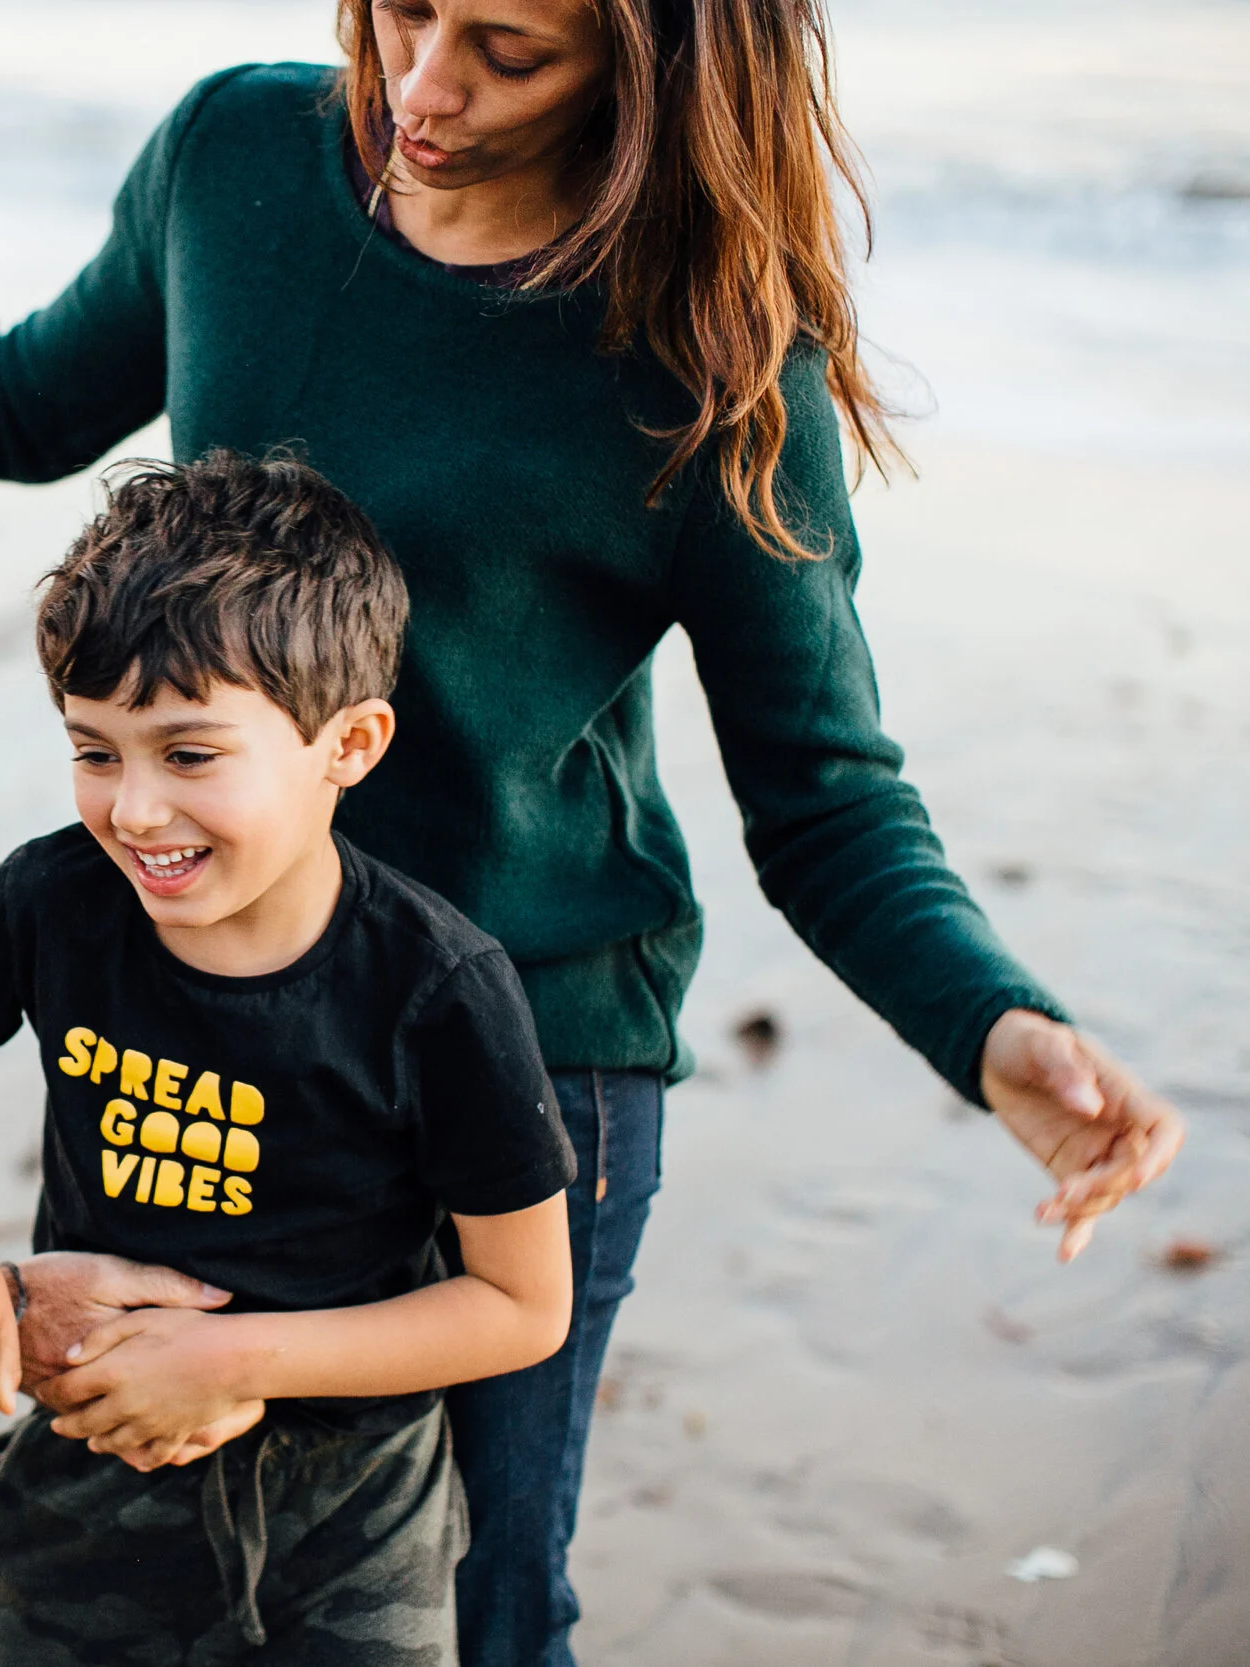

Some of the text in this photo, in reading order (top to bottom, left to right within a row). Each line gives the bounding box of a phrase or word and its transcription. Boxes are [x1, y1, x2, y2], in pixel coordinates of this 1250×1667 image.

[58, 1026, 265, 1126] SPREAD
[100, 1098, 260, 1173] GOOD
[101, 1149, 254, 1216] VIBES
